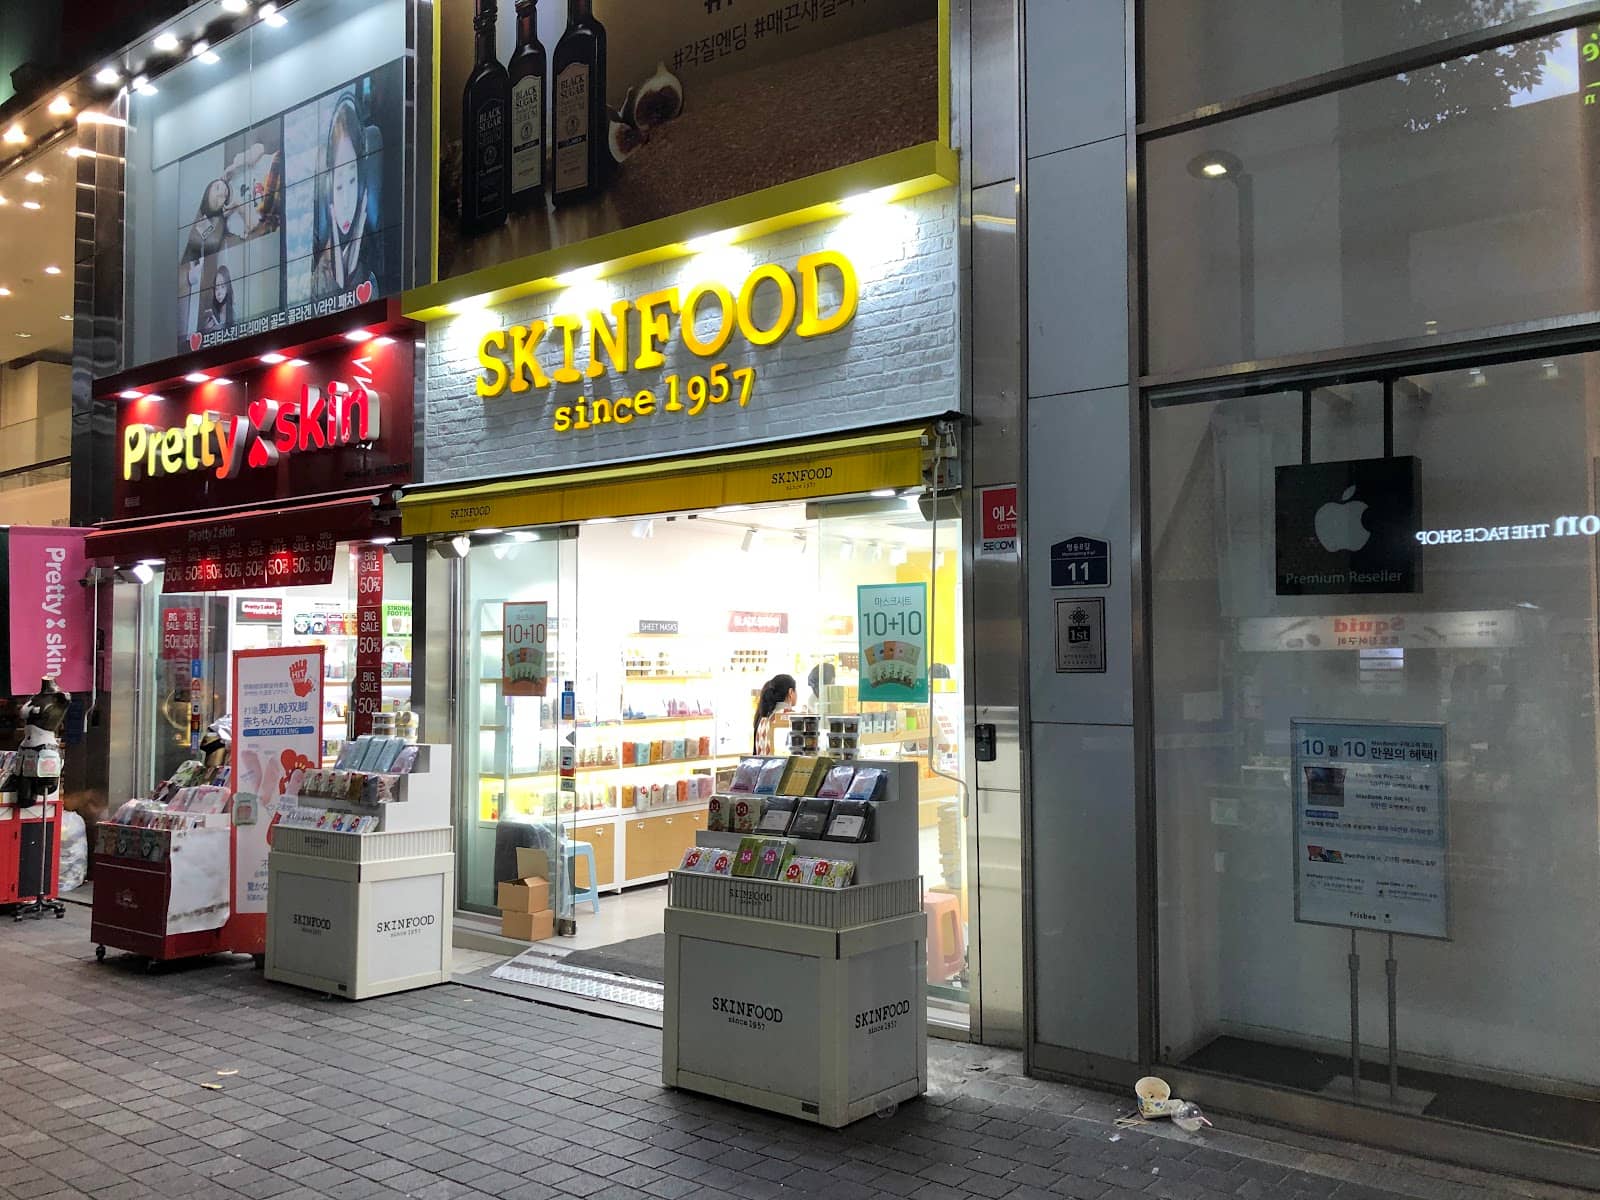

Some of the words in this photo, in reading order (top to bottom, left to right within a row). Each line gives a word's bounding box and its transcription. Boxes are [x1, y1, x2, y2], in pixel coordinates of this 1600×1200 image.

[672, 23, 747, 70] #각질엔딩
[203, 330, 238, 348] 프리티스킨
[240, 317, 269, 338] 프리미엄
[288, 305, 312, 325] 콜라겐
[314, 296, 337, 317] V라인
[475, 250, 859, 398] SKINFOOD
[554, 388, 657, 432] since
[663, 362, 756, 416] 1957
[124, 410, 246, 480] Pretty
[276, 381, 374, 452] skin
[771, 467, 833, 484] SKINFOOD
[450, 505, 491, 519] SKINFOOD
[316, 540, 333, 550] SALE
[984, 541, 1015, 551] SECOM
[364, 551, 377, 561] BIG
[361, 560, 380, 572] SALE
[1068, 562, 1089, 581] 11
[42, 547, 66, 615] Pretty
[359, 576, 381, 593] 50%
[1286, 573, 1345, 585] Premium
[1349, 569, 1402, 583] Reseller
[874, 595, 912, 608] 마스크시트
[363, 611, 376, 622] BIG
[863, 610, 921, 637] 10+10
[360, 621, 379, 632] SALE
[507, 623, 545, 643] 10+10
[640, 622, 659, 632] SHEET
[659, 623, 678, 633] MASKS
[1070, 630, 1089, 641] 1st
[359, 636, 381, 653] 50%
[46, 633, 67, 678] skin
[292, 670, 305, 680] HIT
[363, 672, 375, 681] BIG
[360, 682, 378, 693] SALE
[1302, 739, 1324, 756] 10
[1343, 740, 1366, 758] 10
[1371, 748, 1406, 760] 만원의
[1409, 748, 1438, 762] 혜택!
[293, 914, 331, 931] SKINFOOD
[376, 914, 435, 933] SKINFOOD
[712, 996, 783, 1024] SKINFOOD
[855, 999, 910, 1029] SKINFOOD
[728, 1017, 748, 1026] since
[749, 1020, 766, 1031] 1957
[868, 1025, 883, 1034] since
